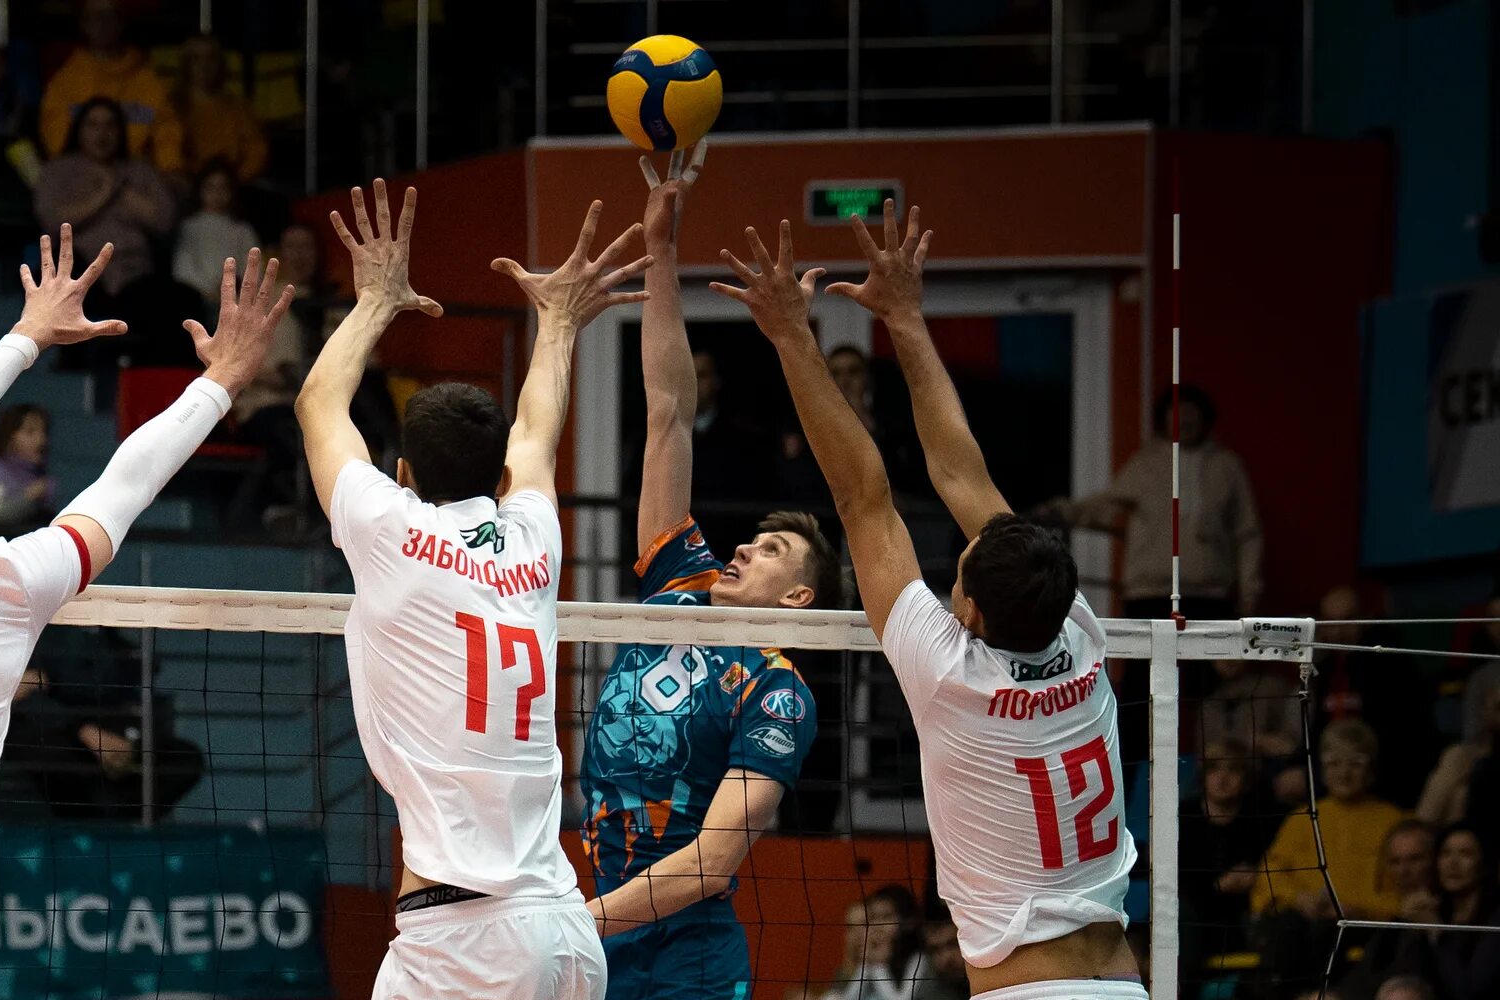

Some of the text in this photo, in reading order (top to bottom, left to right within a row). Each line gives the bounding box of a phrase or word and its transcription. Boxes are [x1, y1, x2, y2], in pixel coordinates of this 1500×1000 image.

[1262, 622, 1302, 633] Senoh
[455, 610, 546, 742] 17
[1013, 734, 1119, 870] 12
[425, 888, 465, 906] NIKE
